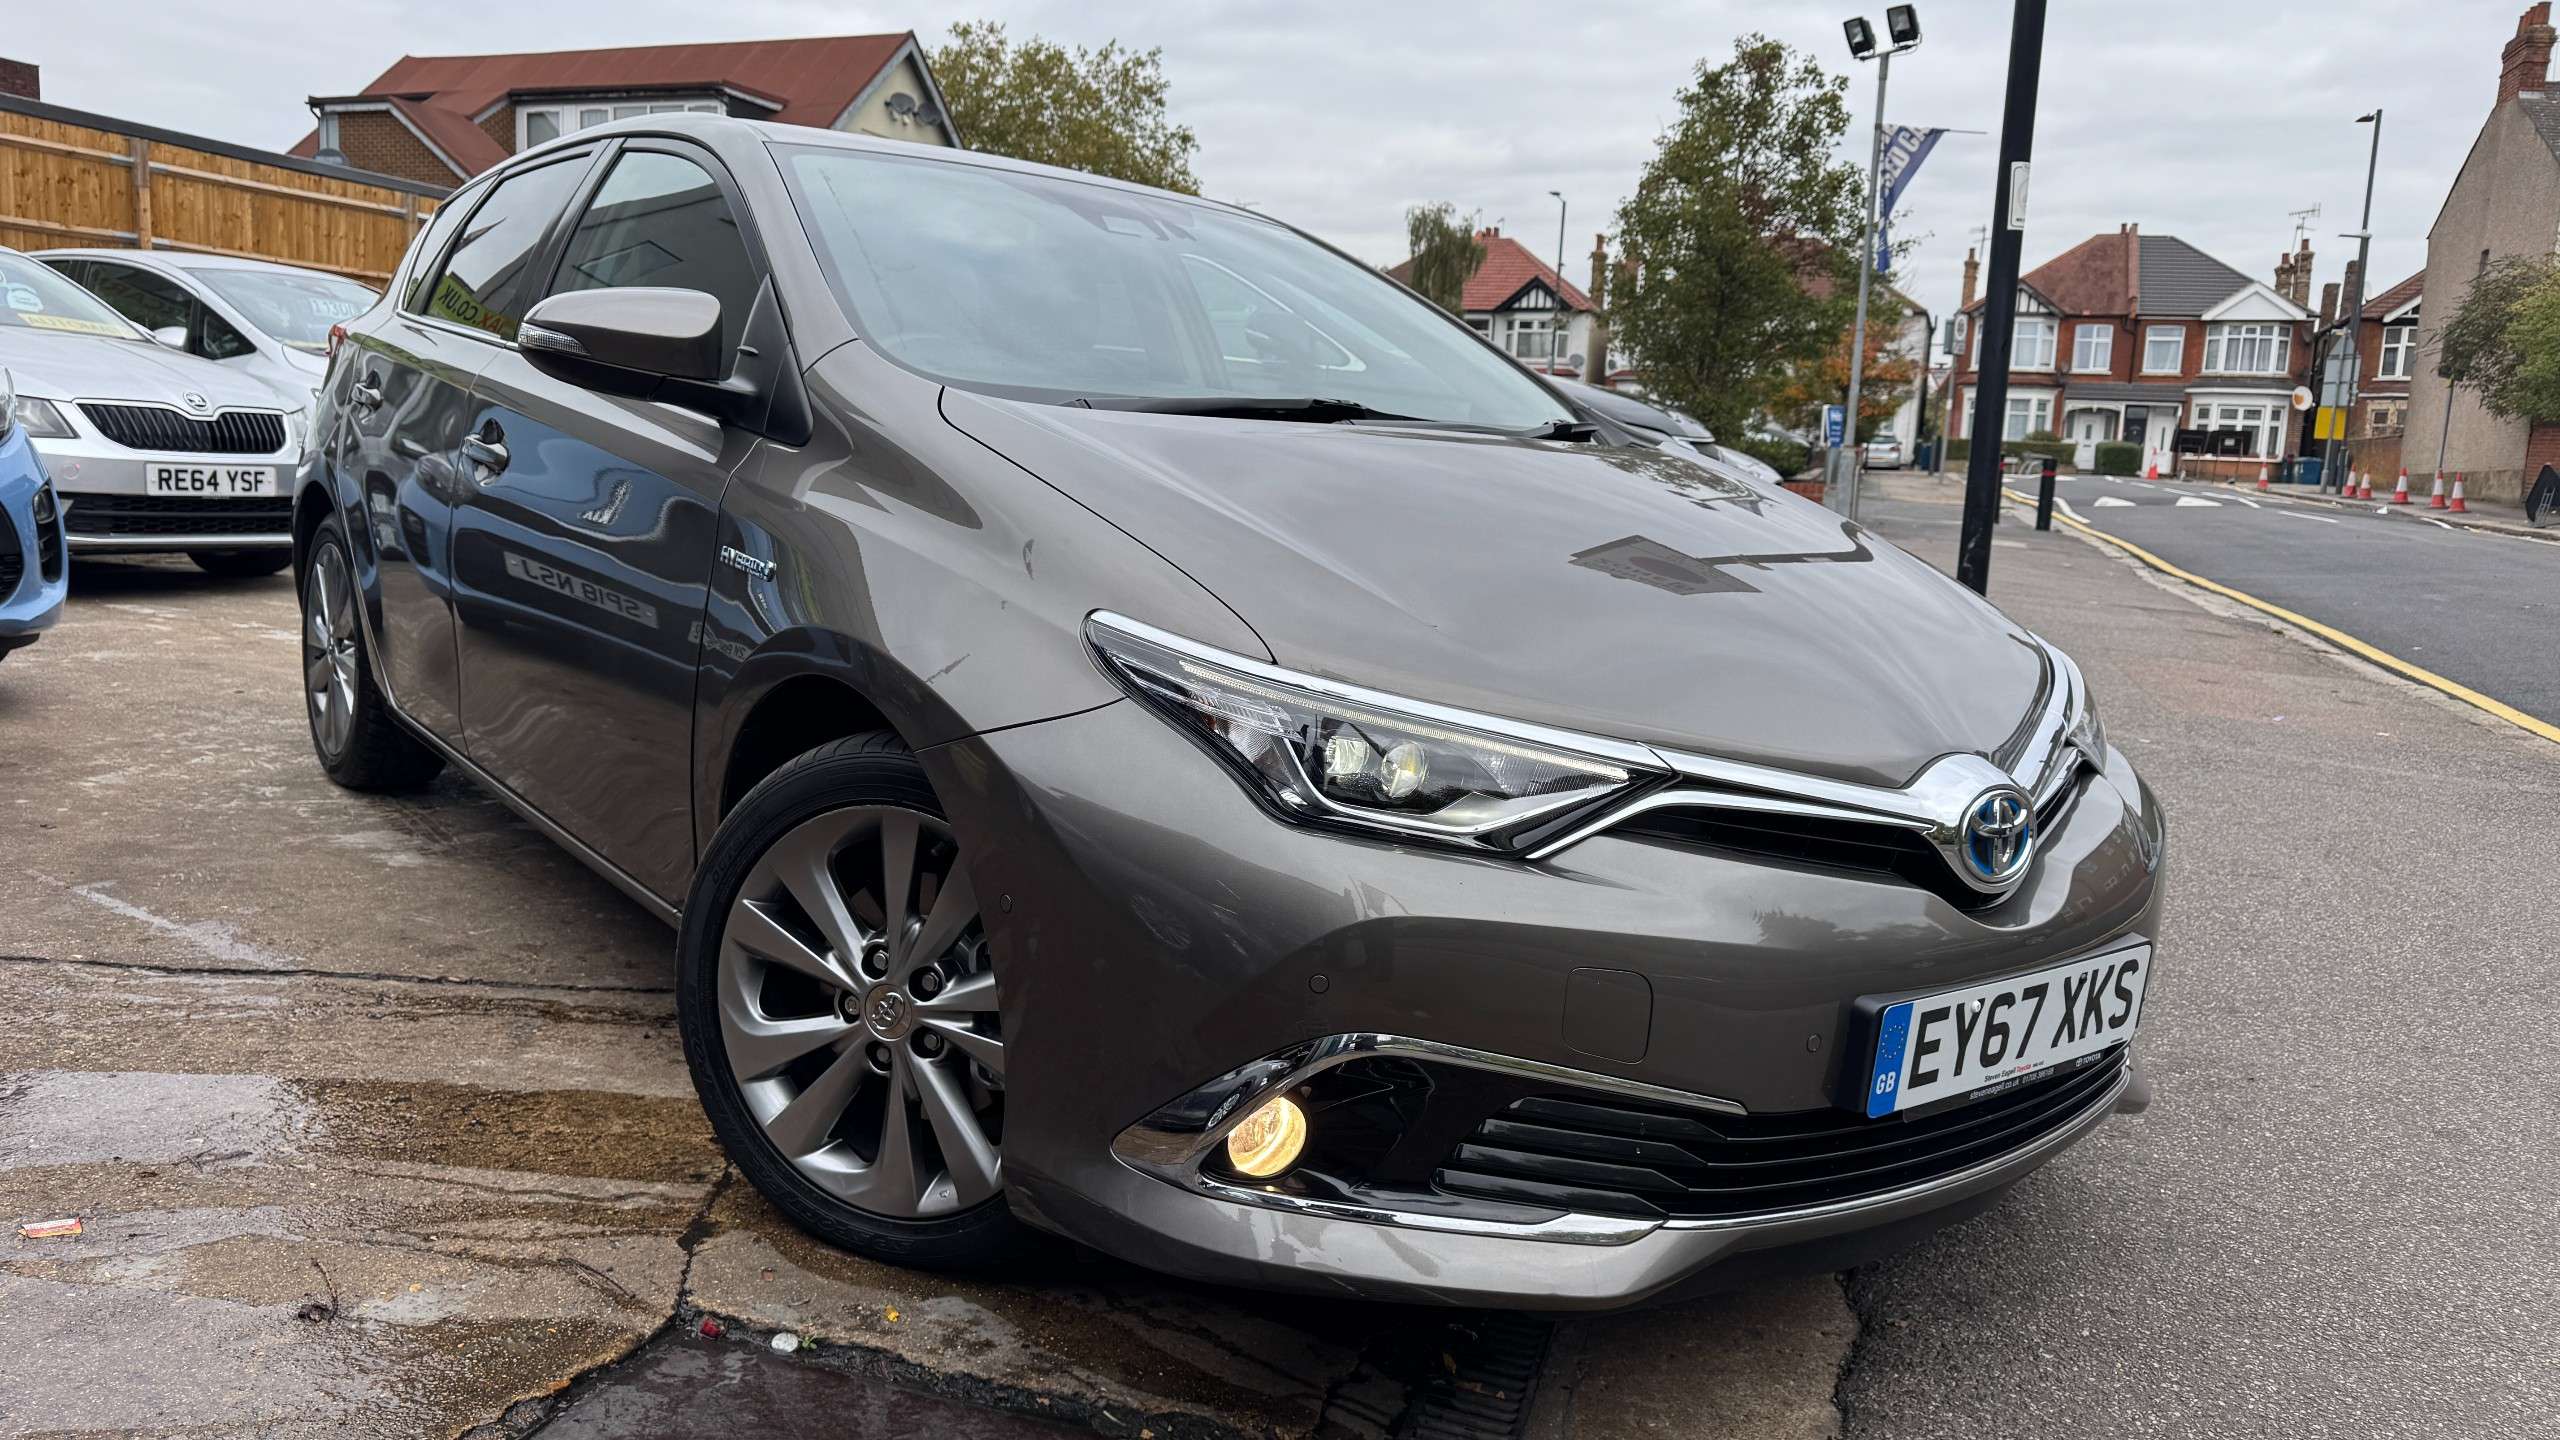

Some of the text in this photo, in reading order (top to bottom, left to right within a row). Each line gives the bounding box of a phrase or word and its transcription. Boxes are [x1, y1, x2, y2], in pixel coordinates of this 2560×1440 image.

[157, 468, 266, 493] RE64 YSF
[1907, 958, 2140, 1090] EY67 XKS
[1875, 1070, 1897, 1095] GB
